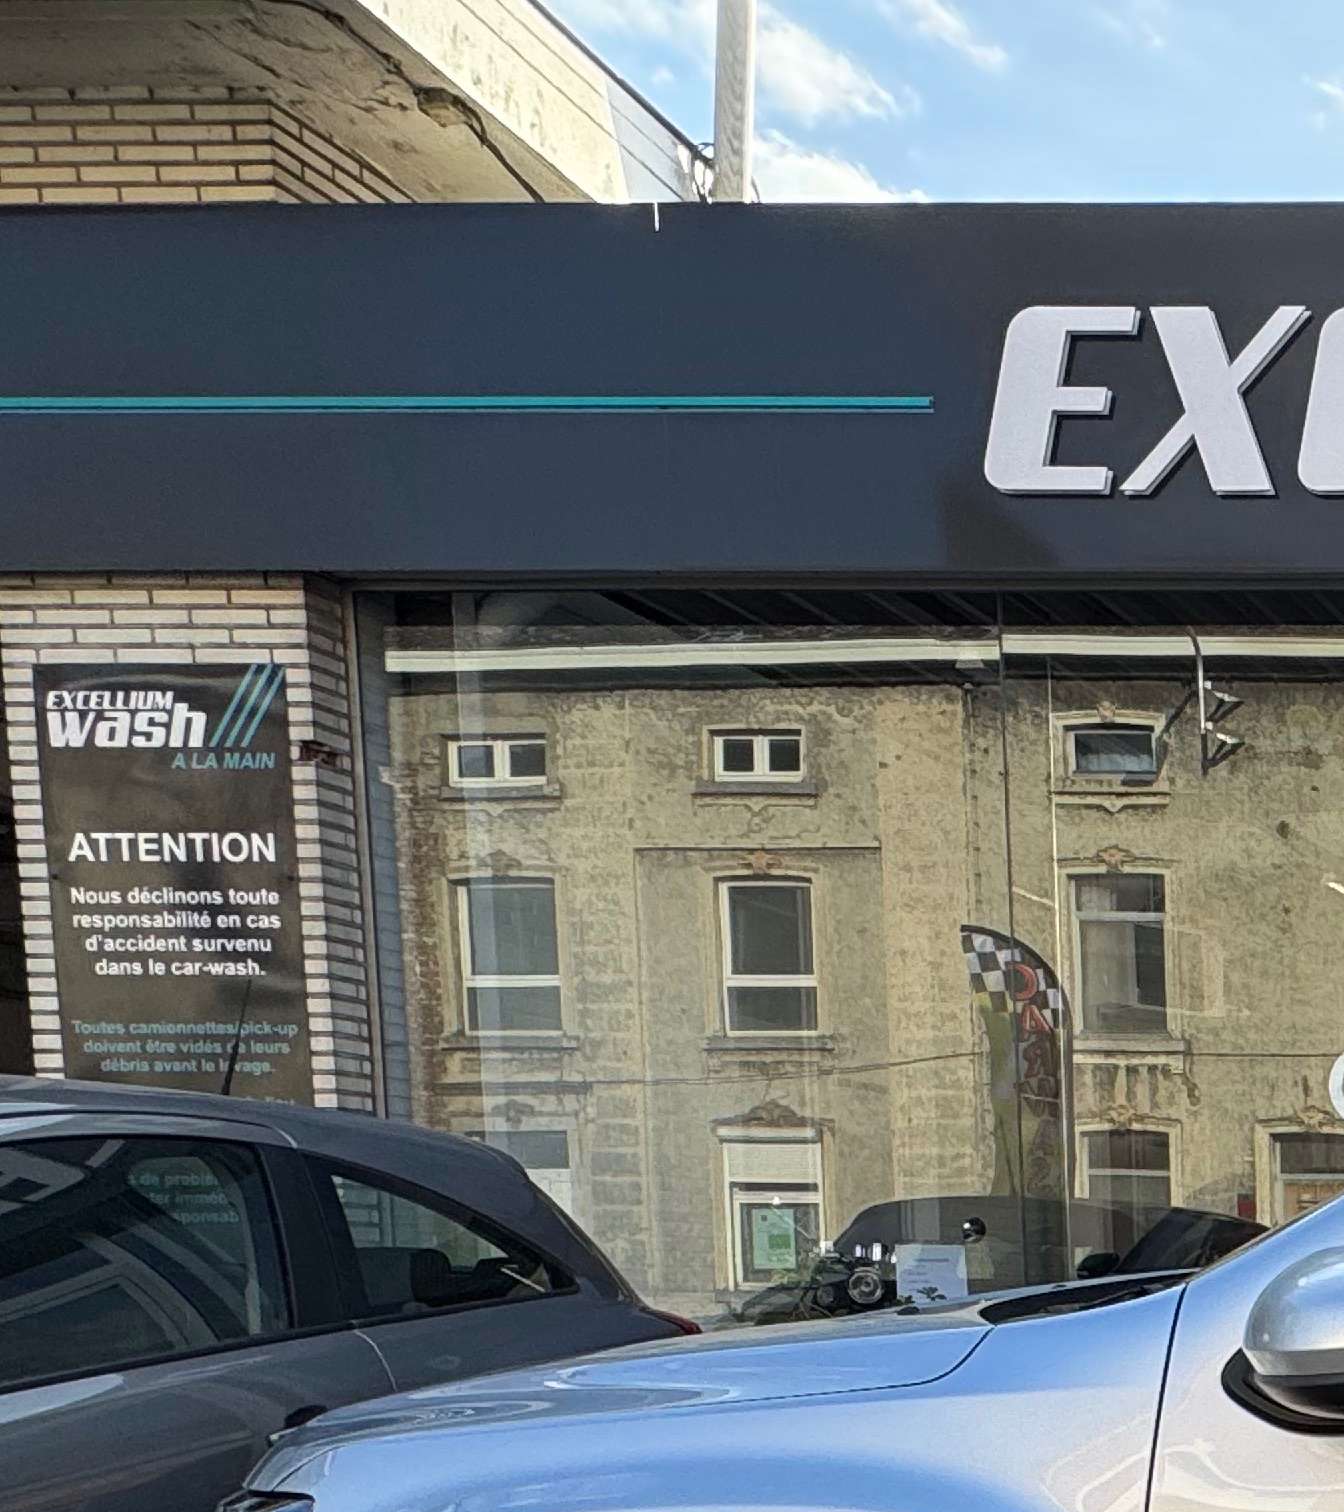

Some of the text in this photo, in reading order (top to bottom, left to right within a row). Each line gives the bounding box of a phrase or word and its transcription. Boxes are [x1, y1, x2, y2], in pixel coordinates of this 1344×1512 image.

[46, 690, 174, 709] EXCELLIUM
[171, 752, 276, 769] A LA MAIN
[67, 832, 276, 862] ATTENTION
[70, 886, 280, 905] Nous déclinons toute
[72, 910, 282, 931] responsabilité en cas
[84, 934, 272, 952] d'accident survenu
[94, 957, 267, 976] dans le car-wash.
[71, 1020, 125, 1036] Toutes
[83, 1039, 142, 1054] doivent
[249, 1039, 291, 1055] leurs
[100, 1057, 150, 1073] débris
[153, 1058, 198, 1073] avant
[201, 1058, 215, 1073] le
